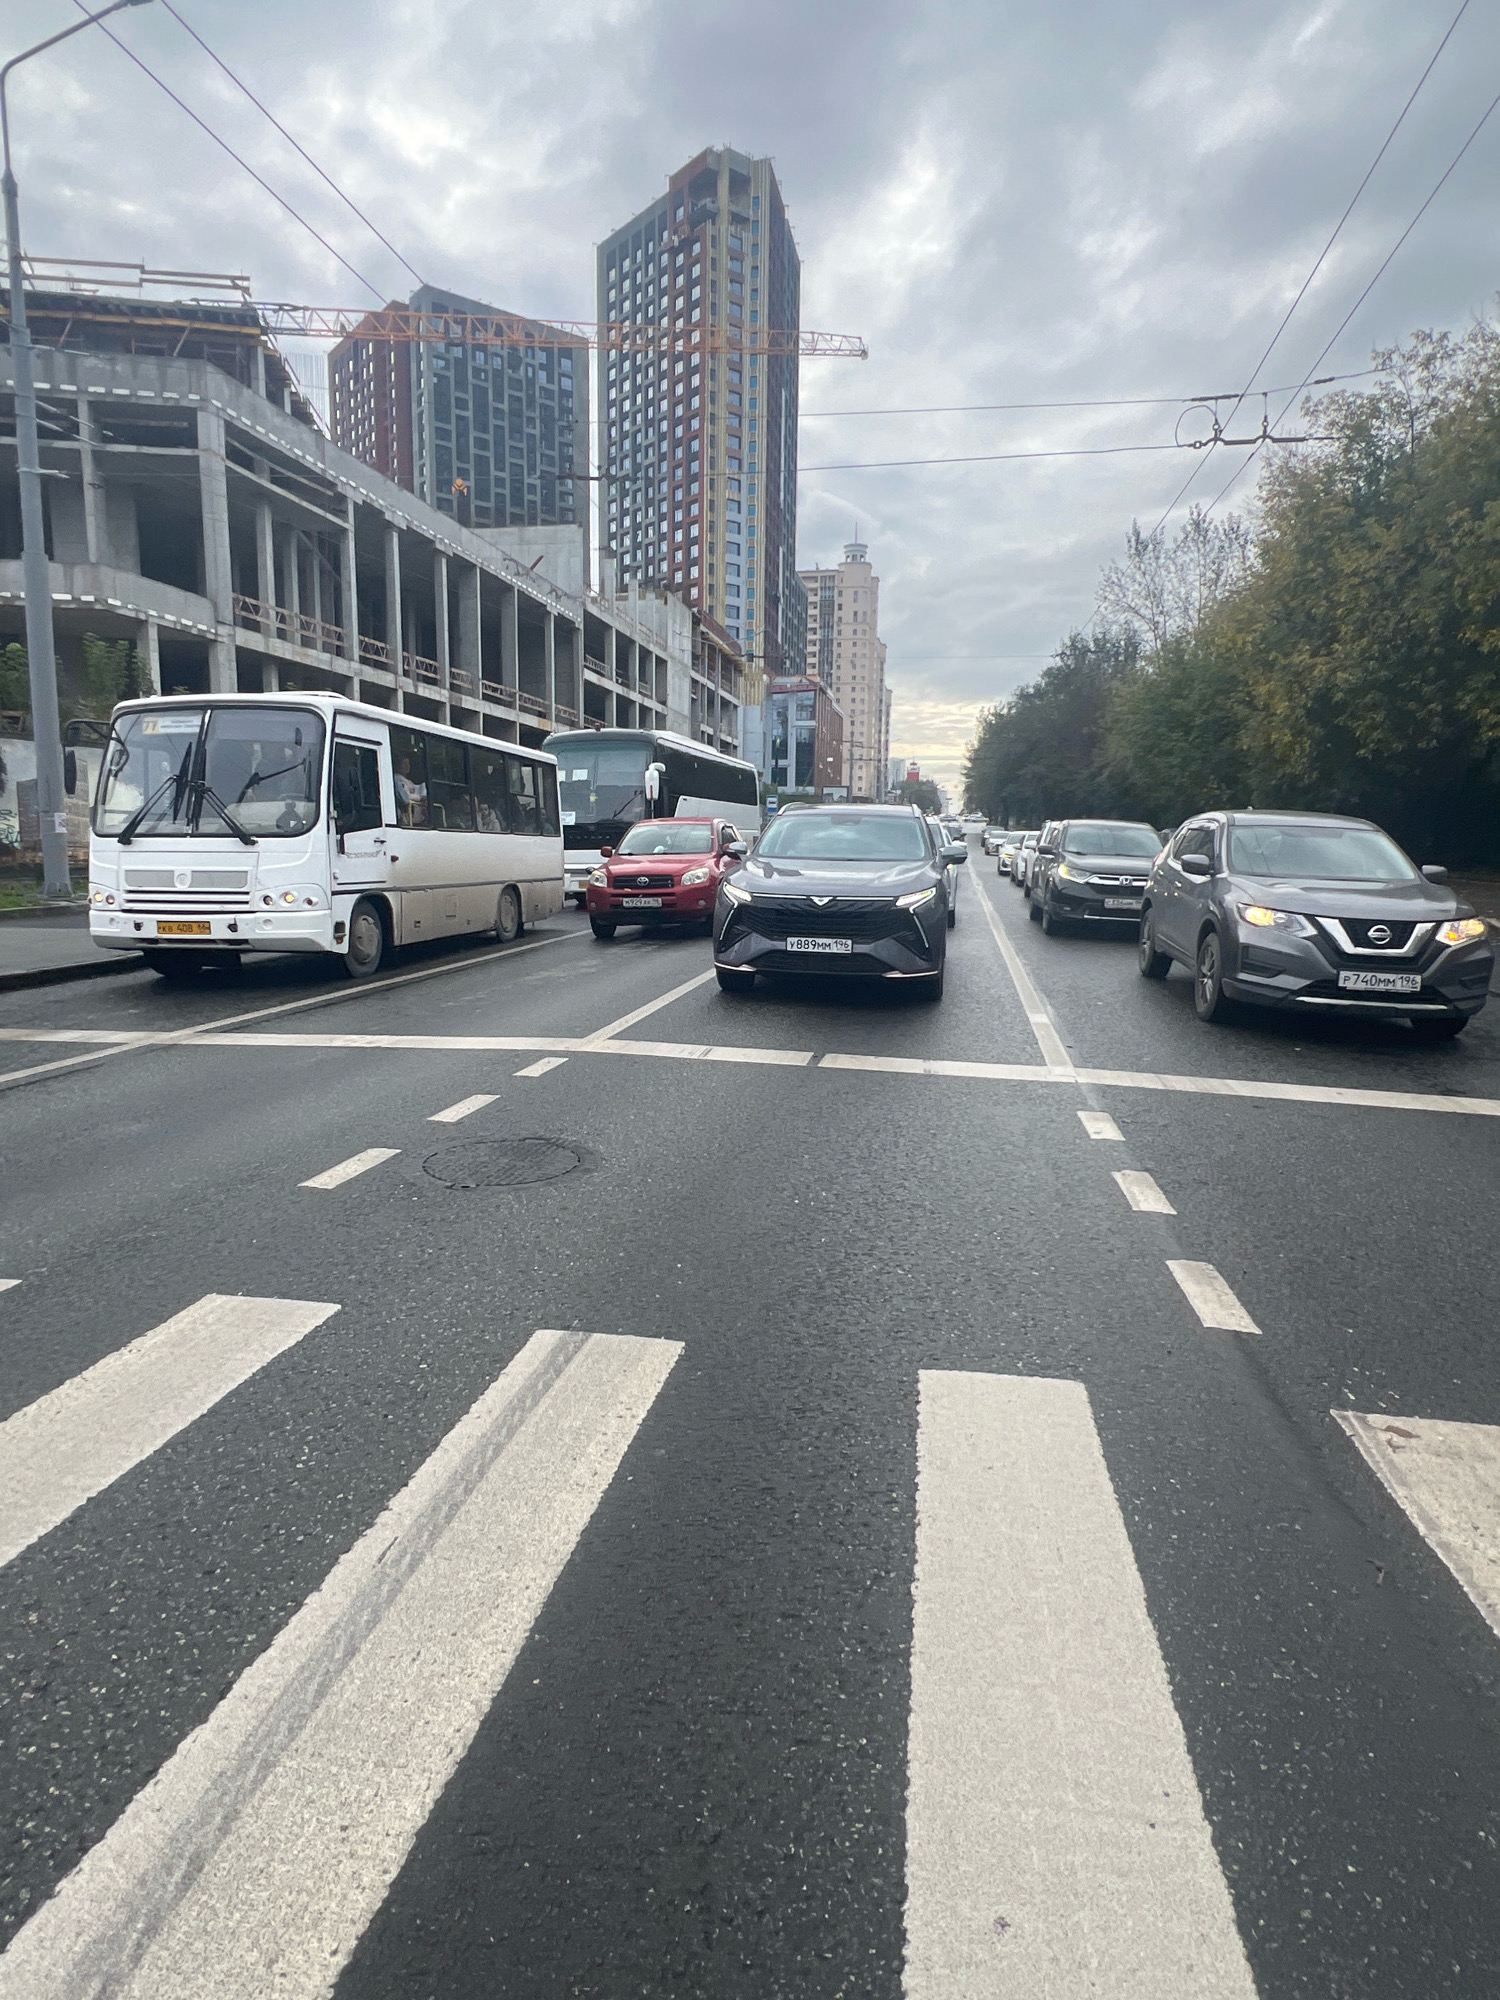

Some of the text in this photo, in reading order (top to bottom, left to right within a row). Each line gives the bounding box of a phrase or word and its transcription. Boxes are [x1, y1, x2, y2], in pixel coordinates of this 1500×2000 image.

[790, 939, 849, 950] У889ММ 196
[1343, 973, 1418, 987] Р740ММ 196
